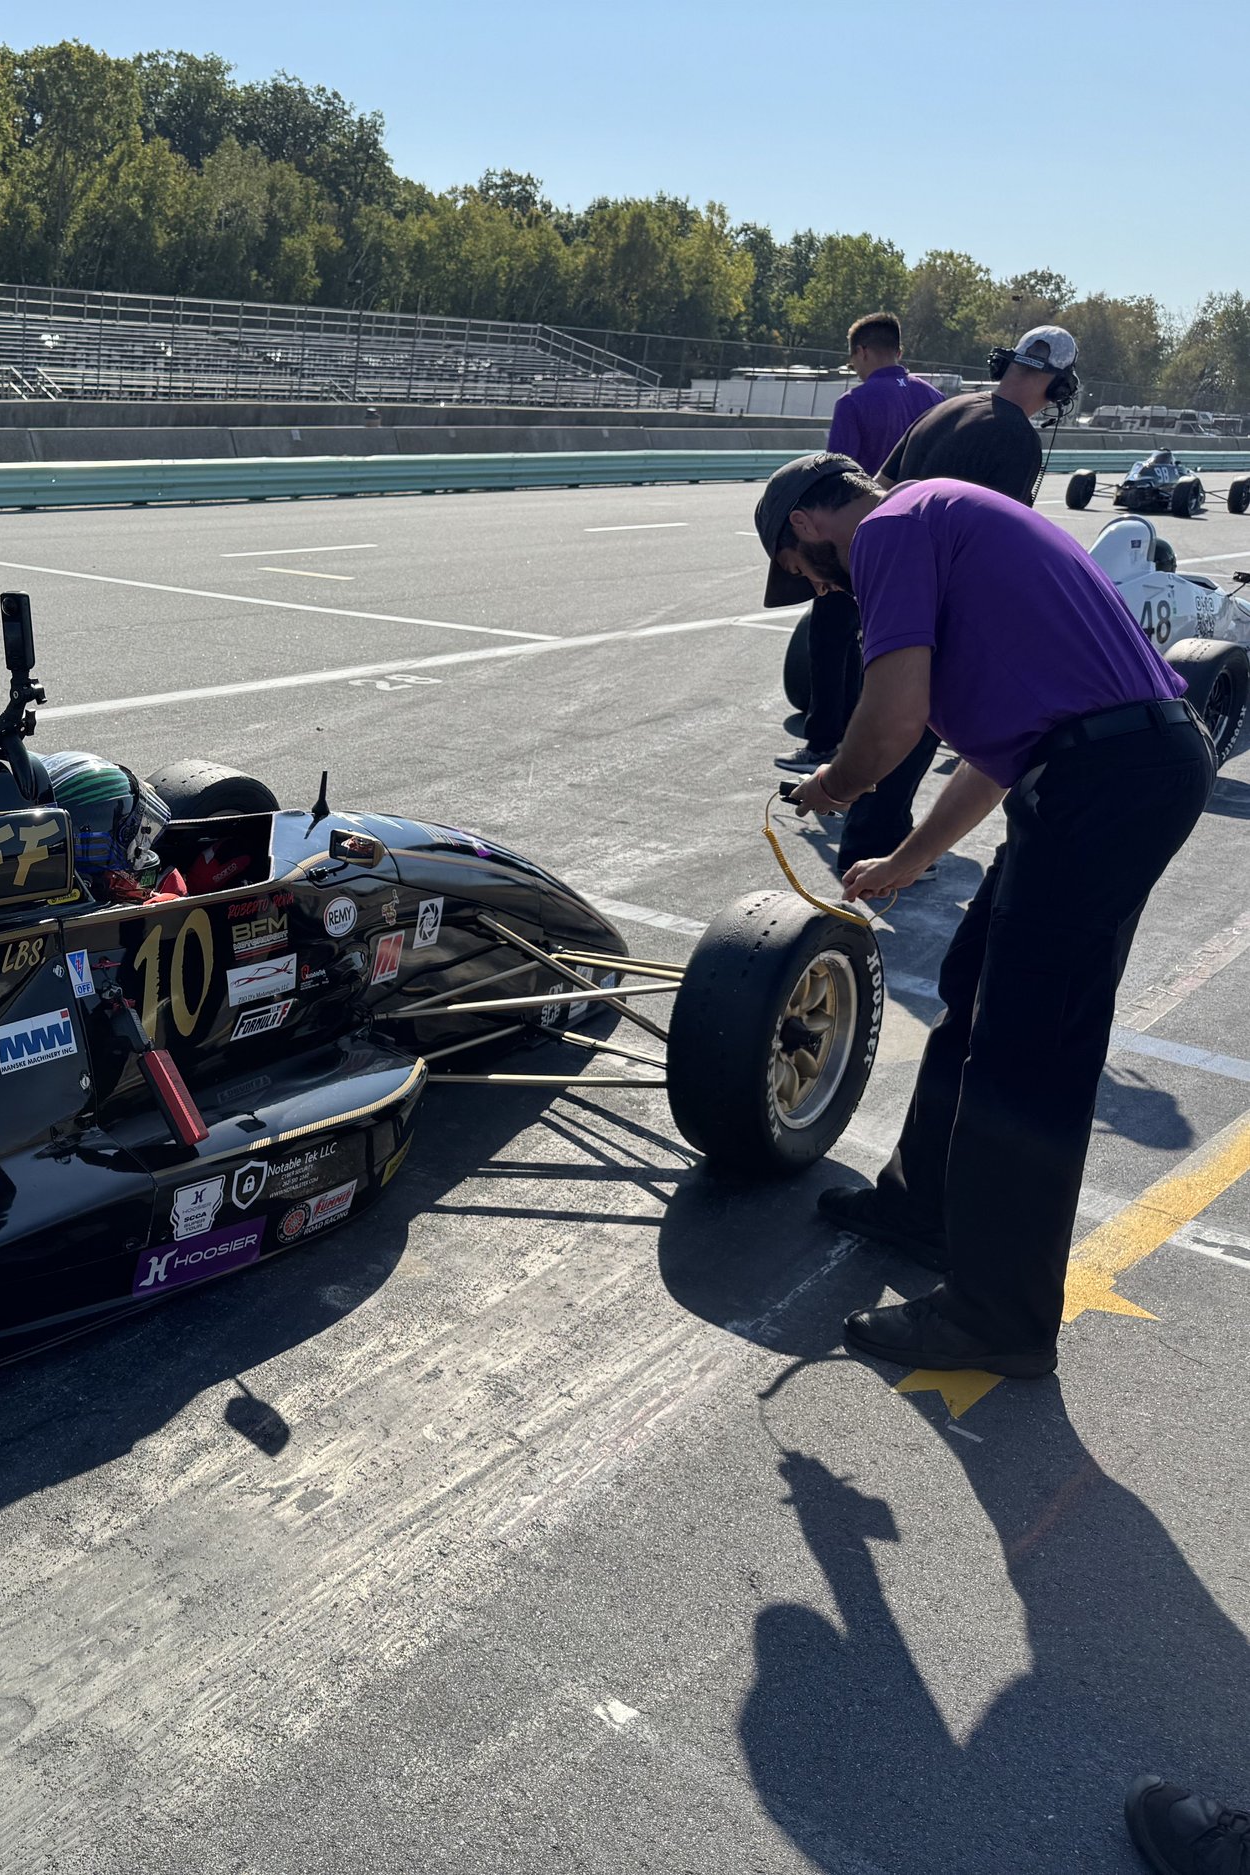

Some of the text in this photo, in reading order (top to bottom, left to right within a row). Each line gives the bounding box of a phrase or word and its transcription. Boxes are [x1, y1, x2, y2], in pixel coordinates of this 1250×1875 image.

[1155, 467, 1169, 483] 98
[1140, 600, 1171, 644] 48
[231, 913, 288, 943] BFM
[328, 906, 352, 926] REMY
[2, 937, 46, 974] LBS.
[133, 908, 214, 1042] 10
[77, 984, 91, 994] OFF
[233, 1012, 279, 1038] FORMULA
[1, 1046, 75, 1073] MANSKE MACHINERY INC.
[267, 1141, 338, 1177] Notable Tek LLC
[182, 1202, 212, 1214] HOOSIER
[184, 1211, 207, 1223] SCCA
[184, 1218, 206, 1229] SUPER
[185, 1223, 203, 1232] TOUR
[303, 1221, 324, 1236] ROAD
[323, 1208, 350, 1227] RACING
[173, 1233, 258, 1269] HOOSIER
